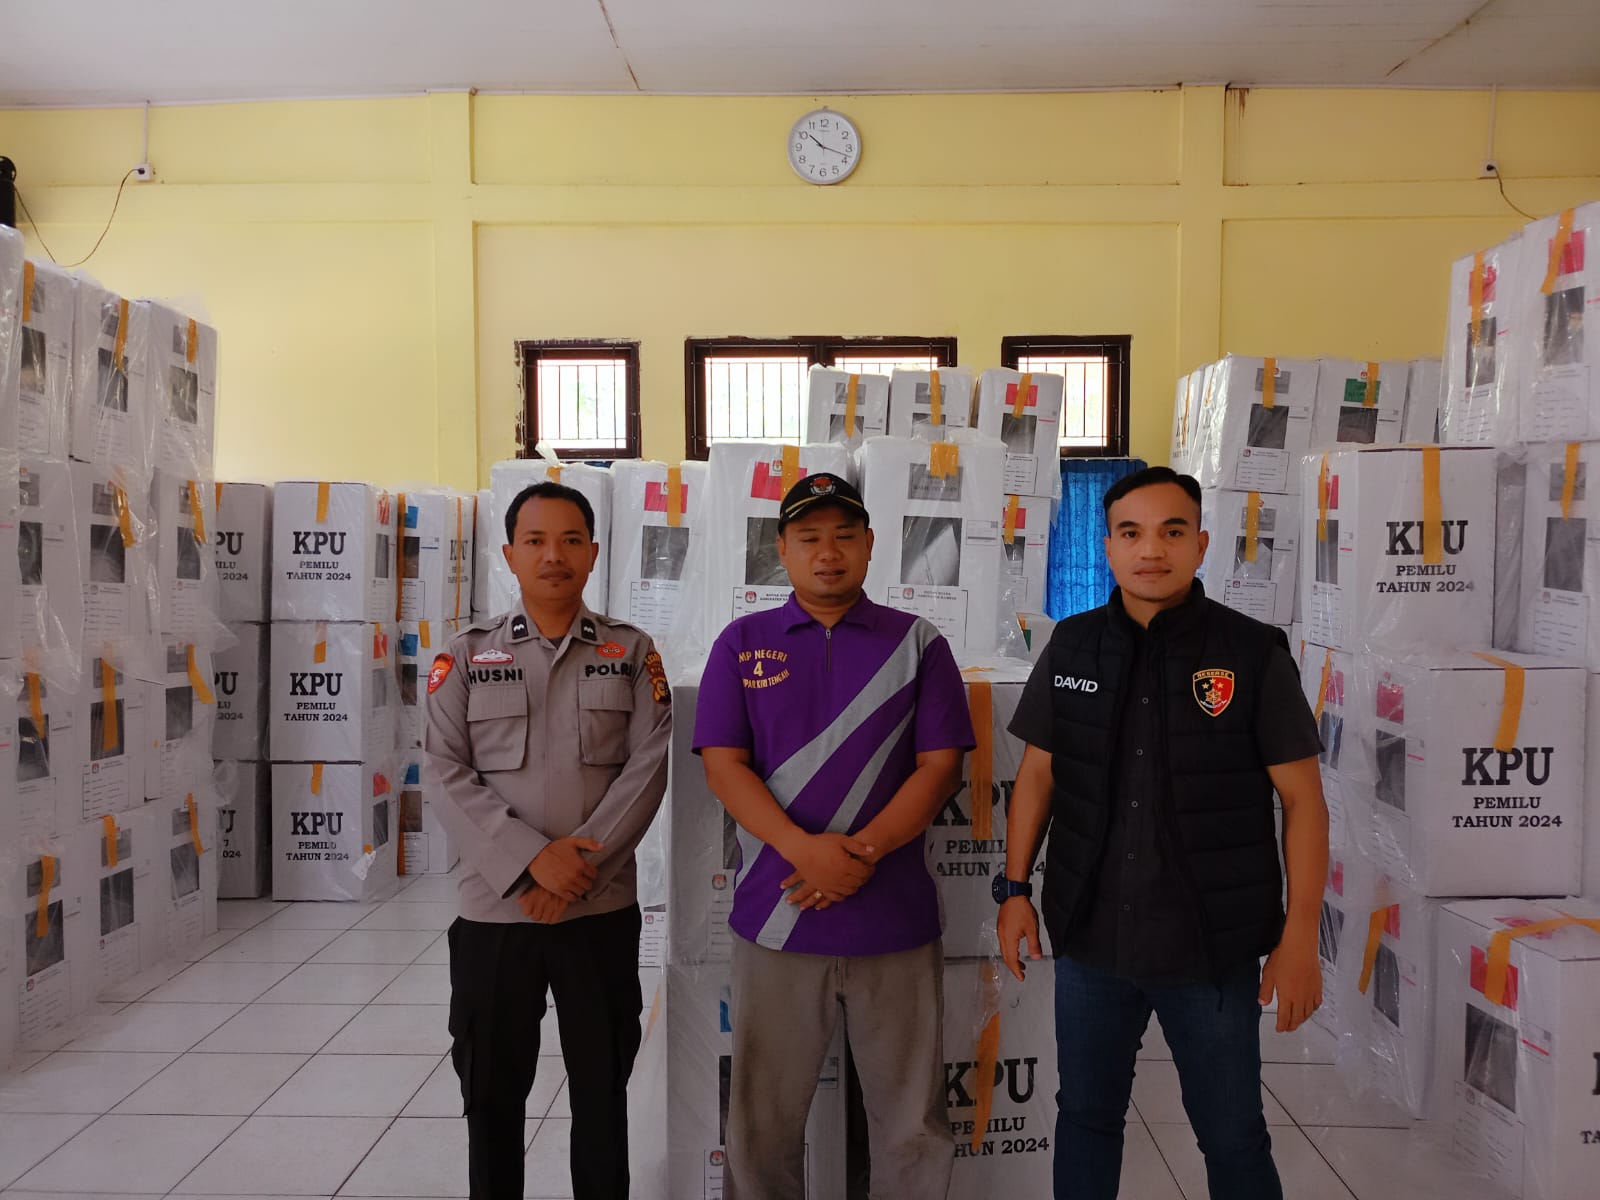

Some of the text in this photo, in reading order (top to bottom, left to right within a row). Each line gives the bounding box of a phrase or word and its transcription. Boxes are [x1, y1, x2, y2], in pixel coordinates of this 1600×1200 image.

[808, 121, 815, 130] 11
[820, 119, 829, 128] 12
[835, 122, 839, 130] 1
[799, 131, 808, 140] 10
[841, 131, 849, 140] 2
[795, 143, 803, 152] 9
[845, 144, 853, 153] 3
[798, 155, 806, 164] 8
[841, 156, 848, 165] 4
[809, 164, 815, 174] 7
[819, 167, 827, 177] 6
[832, 165, 839, 175] 5
[215, 531, 244, 556] PU
[292, 531, 347, 556] KPU
[299, 561, 340, 569] PEMILU
[1395, 564, 1457, 577] PEMILU
[223, 572, 248, 581] 2024
[286, 572, 352, 581] TAHUN 2024
[1376, 580, 1475, 593] TAHUN 2024
[754, 649, 788, 663] NEGERI
[585, 662, 634, 678] POLRI
[753, 661, 764, 677] 4
[468, 667, 523, 685] HUSNI
[290, 672, 343, 697] KPU
[1054, 674, 1099, 693] DAVID
[296, 702, 336, 711] PEMILU
[217, 712, 244, 721] 2024
[284, 713, 349, 722] TAHUN 2024
[1461, 746, 1554, 786] KPU
[1473, 796, 1541, 809] PEMILU
[291, 811, 344, 836] KPU
[1452, 815, 1563, 828] TAHUN 2024
[298, 841, 337, 850] PEMILU
[945, 840, 1007, 854] PEMIL
[222, 850, 242, 859] 024
[285, 852, 350, 861] TAHUN 2024
[936, 861, 991, 877] AHUN
[953, 1136, 1050, 1158] HUN 2024
